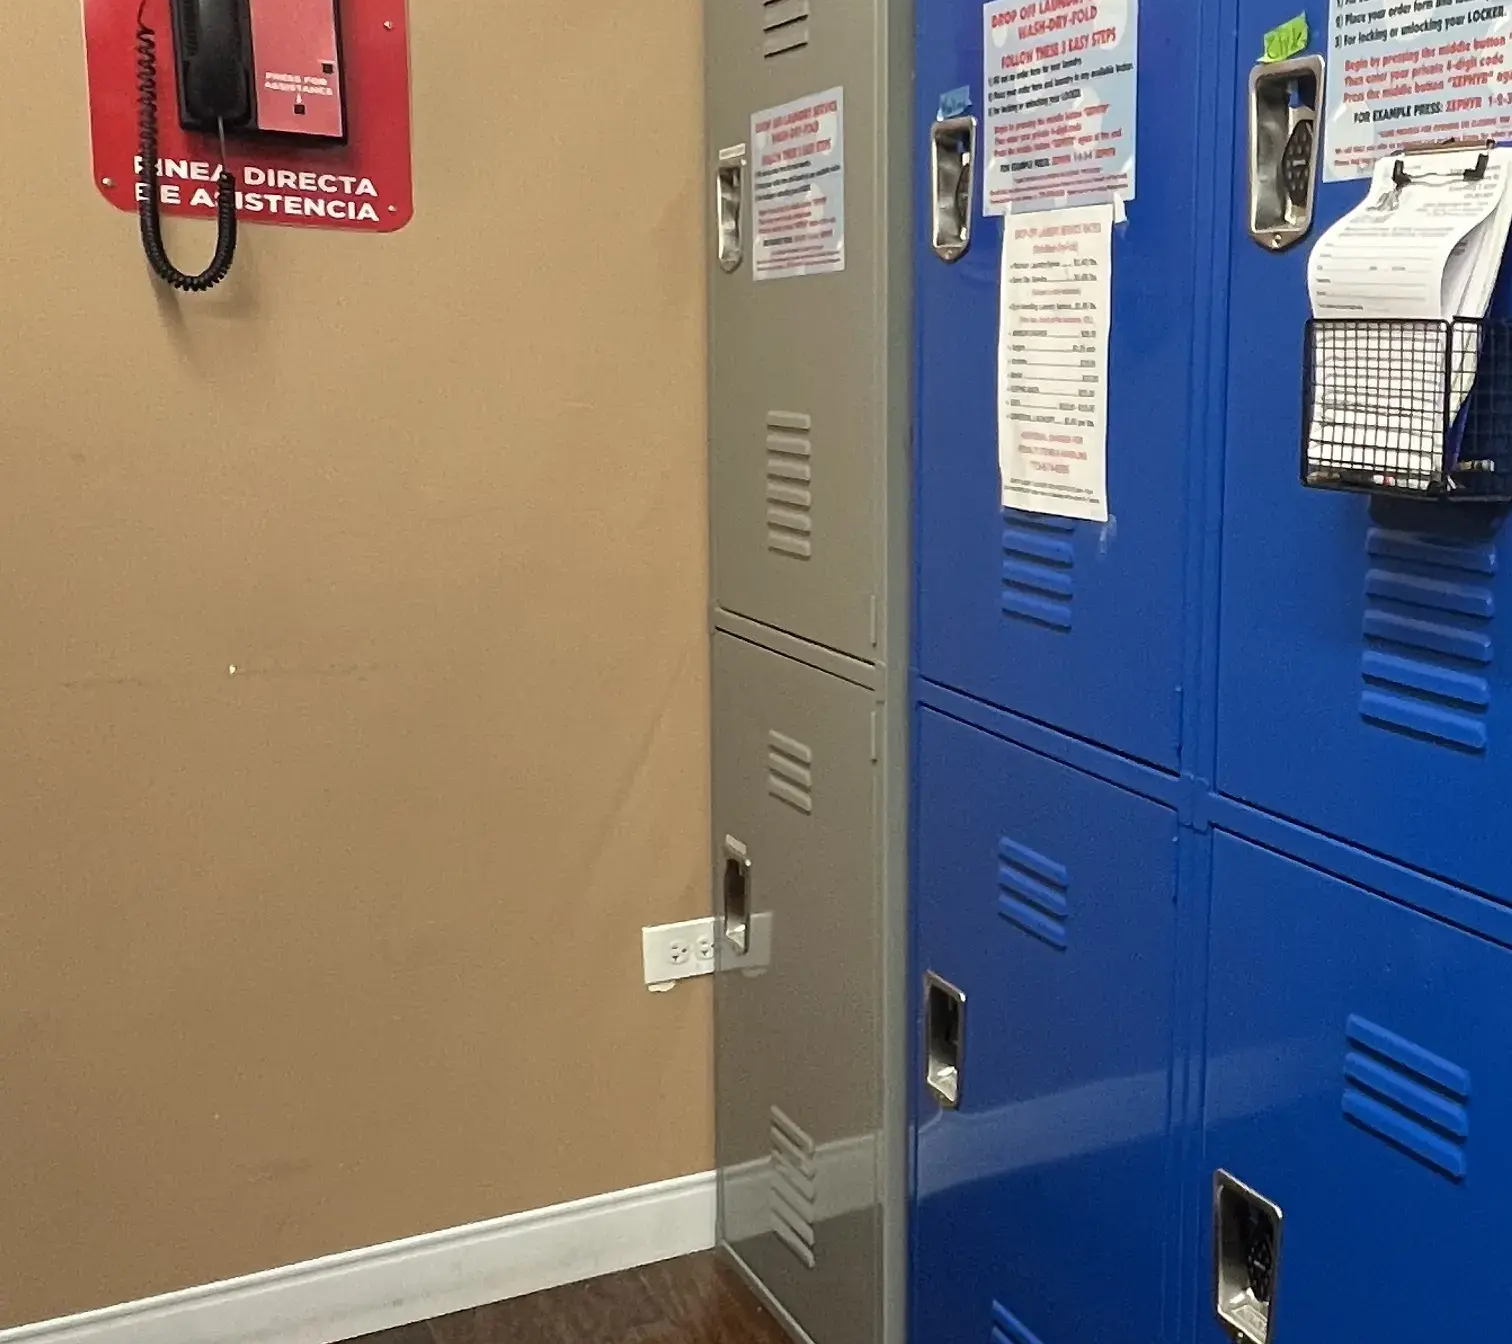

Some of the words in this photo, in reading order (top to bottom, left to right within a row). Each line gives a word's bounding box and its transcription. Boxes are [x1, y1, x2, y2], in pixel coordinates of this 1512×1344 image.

[1388, 3, 1412, 17] order
[1414, 0, 1433, 13] form
[1358, 28, 1388, 44] locking
[1401, 18, 1443, 36] unlocking
[1445, 15, 1465, 30] your
[244, 166, 379, 197] DIRECTA
[190, 188, 380, 221] AISTENCIA
